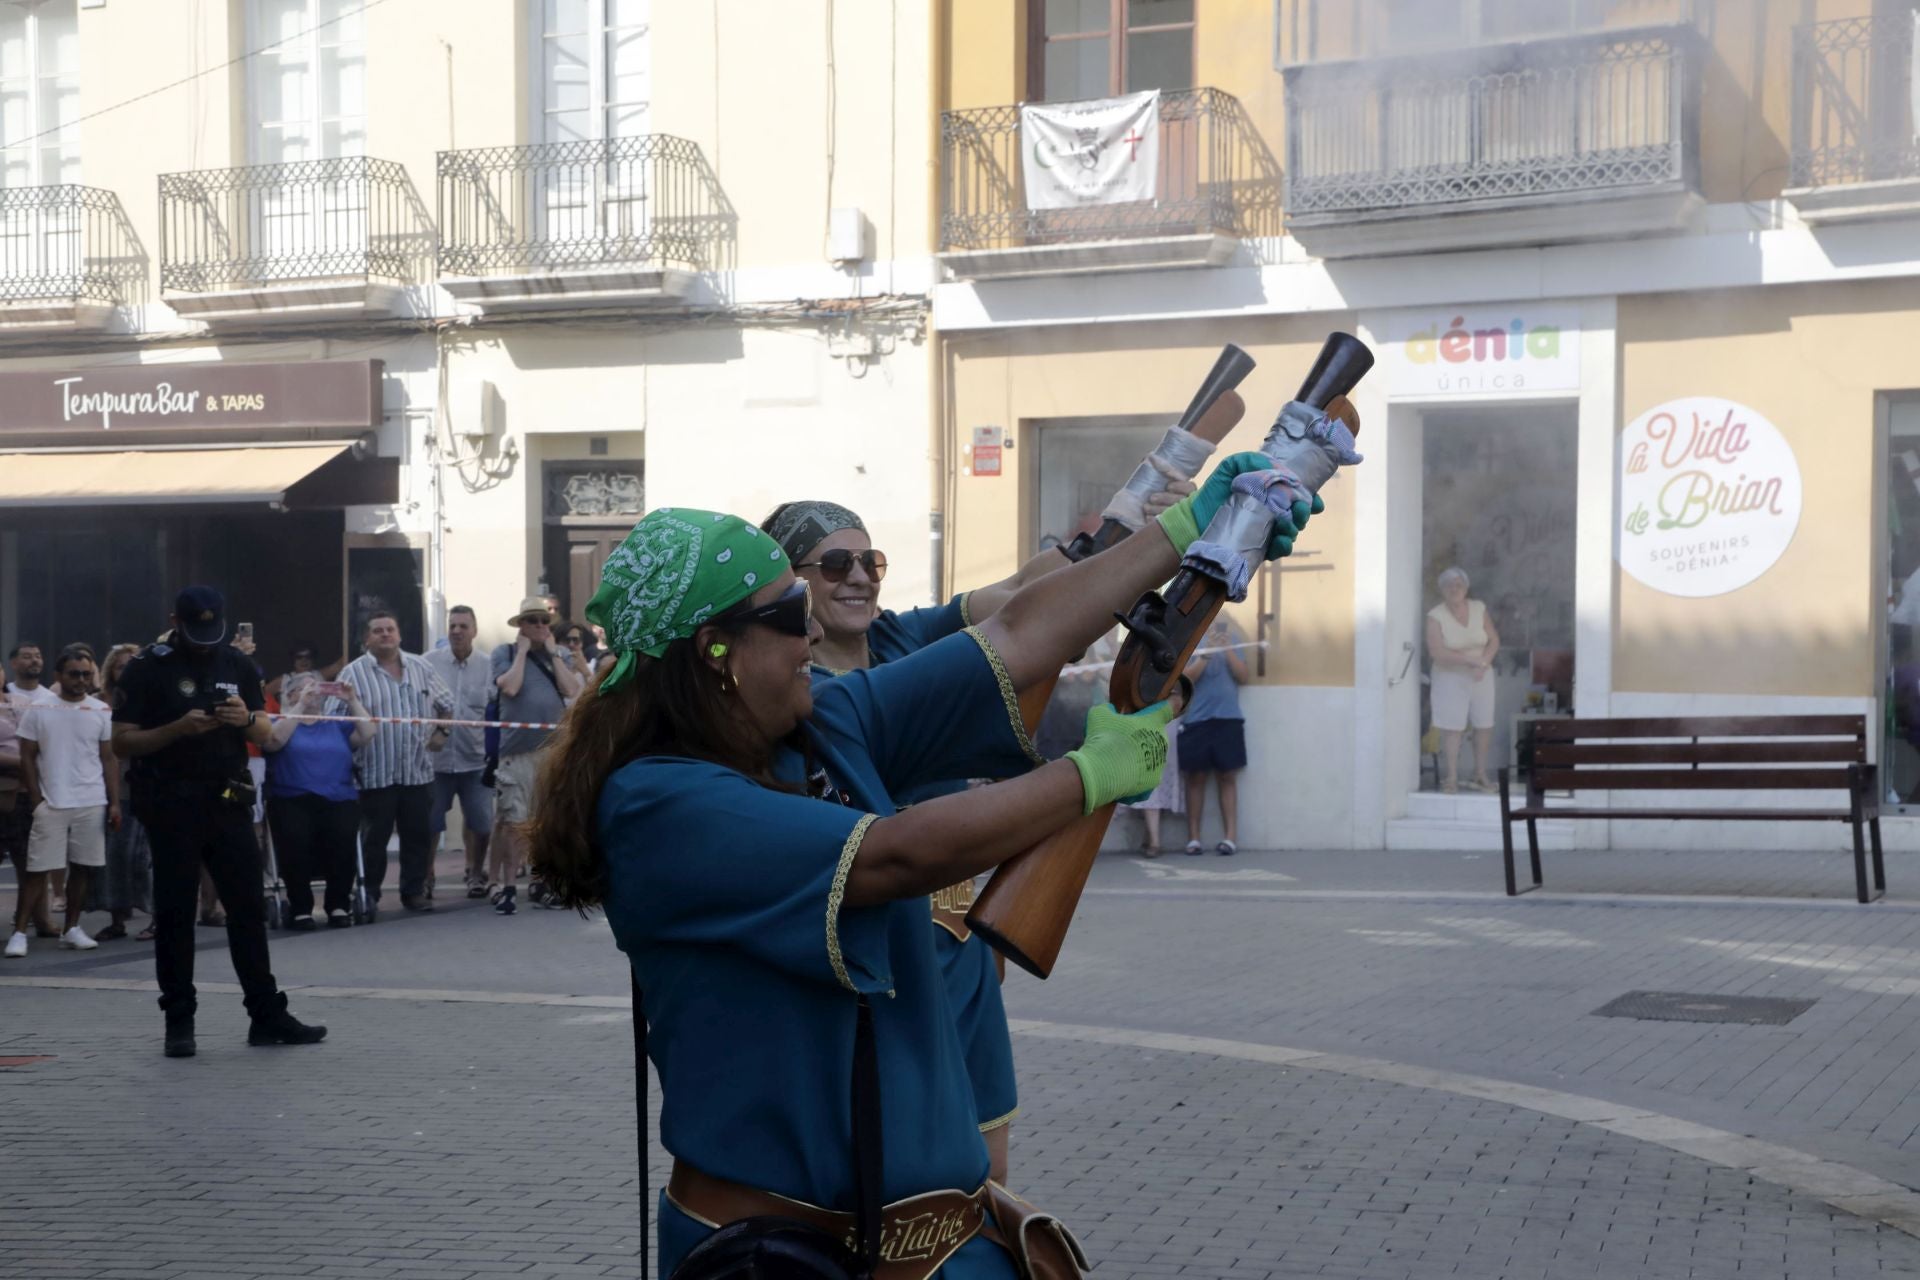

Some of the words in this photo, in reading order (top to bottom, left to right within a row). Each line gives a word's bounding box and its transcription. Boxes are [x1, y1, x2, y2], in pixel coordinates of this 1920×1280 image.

[1404, 315, 1560, 364] dénia
[1437, 373, 1526, 391] única
[206, 395, 218, 412] &
[221, 394, 264, 412] TAPAS
[1646, 409, 1750, 469] Vida
[1624, 501, 1649, 536] de
[1656, 470, 1783, 530] Brian
[1649, 535, 1750, 563] SOUVENIRS
